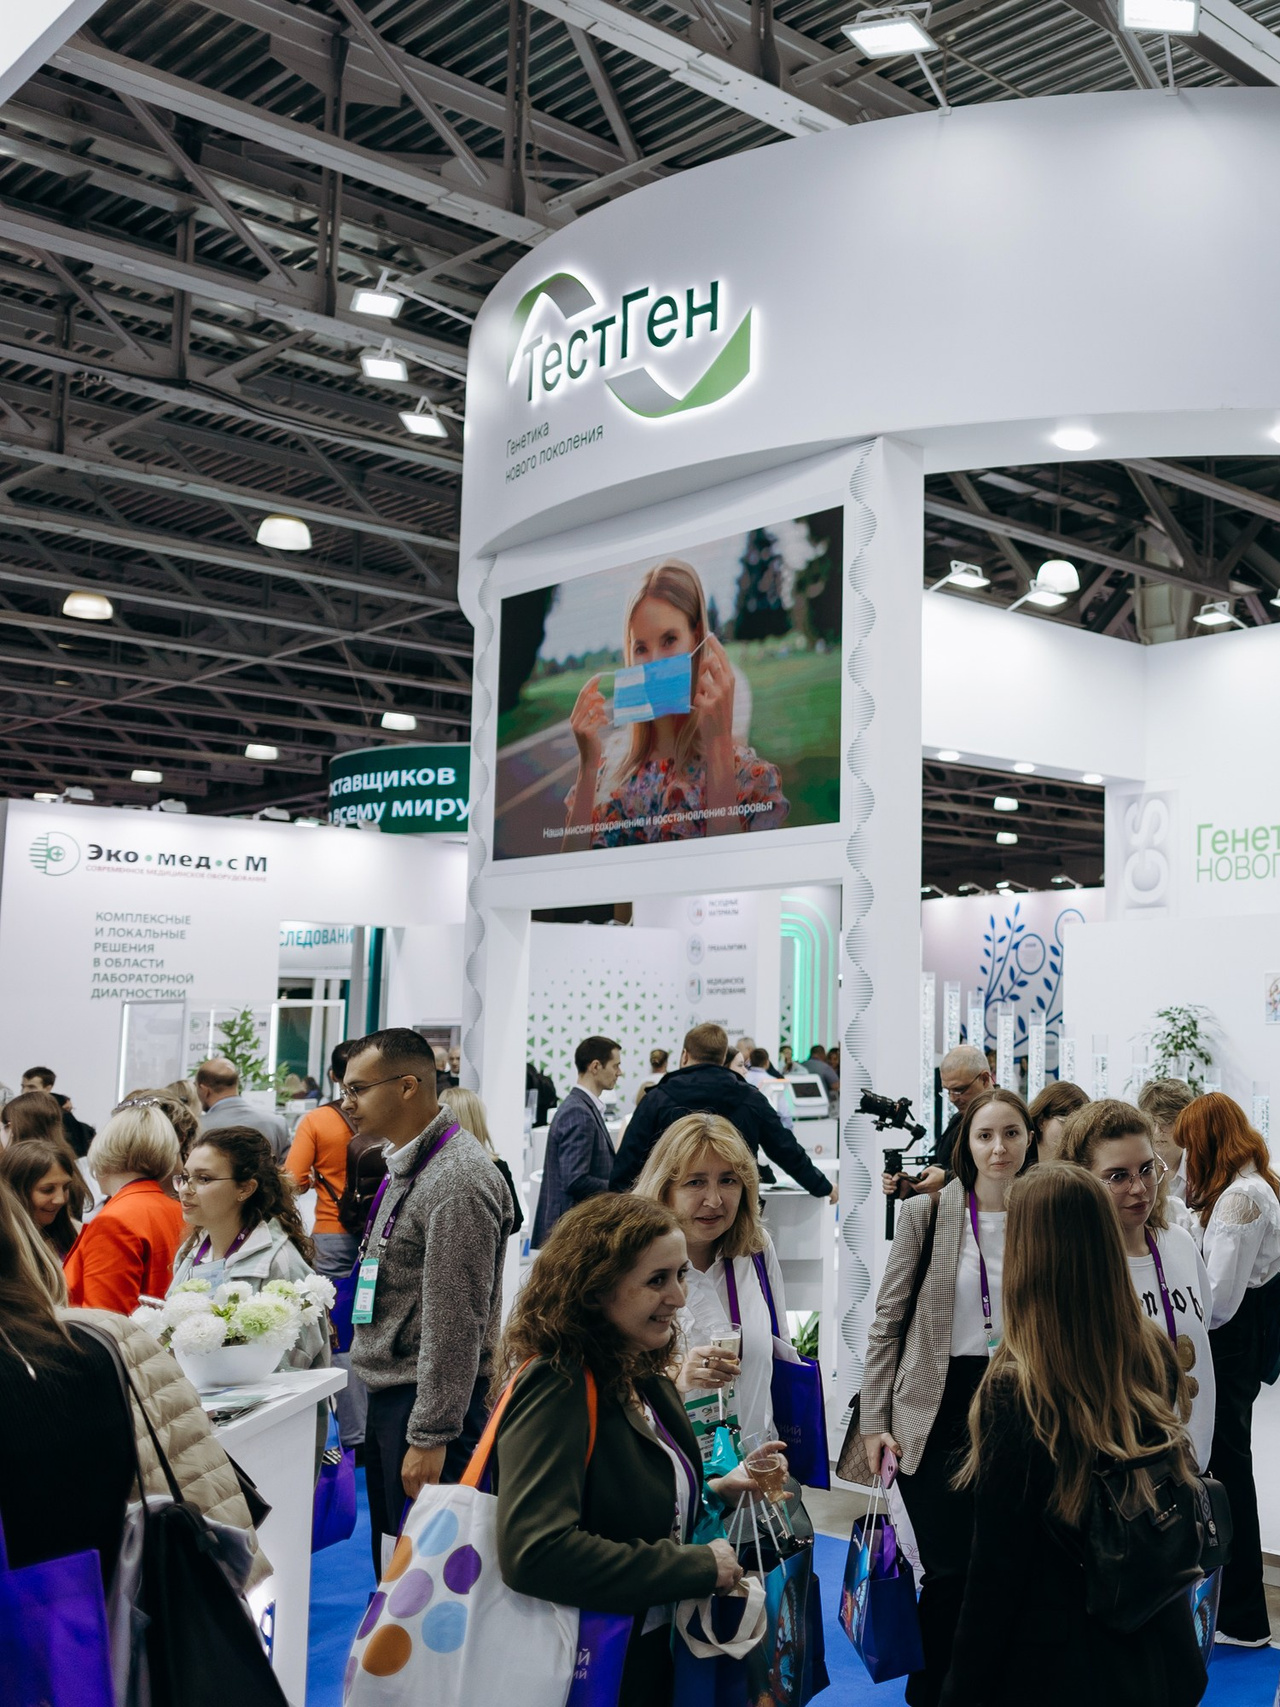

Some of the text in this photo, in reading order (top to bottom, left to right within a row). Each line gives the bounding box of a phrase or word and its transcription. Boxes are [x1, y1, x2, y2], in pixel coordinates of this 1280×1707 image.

[523, 280, 719, 401] ТестГен
[506, 421, 550, 458] Генетика
[505, 424, 604, 484] нового поколения
[329, 767, 456, 797] ставщиков
[391, 797, 470, 822] миру
[543, 800, 773, 838] Наша миссия сохранение и восстановление здоровья
[96, 912, 191, 925] КОМПЛЕКСНЫЕ
[95, 927, 187, 939] И ЛОКАЛЬНЫЕ
[94, 942, 155, 953] РЕШЕНИЯ
[93, 958, 165, 969] В ОБЛАСТИ
[92, 972, 195, 984] ЛАБОРАТОРНОЙ
[91, 988, 187, 1000] ДИАГНОСТИКИ
